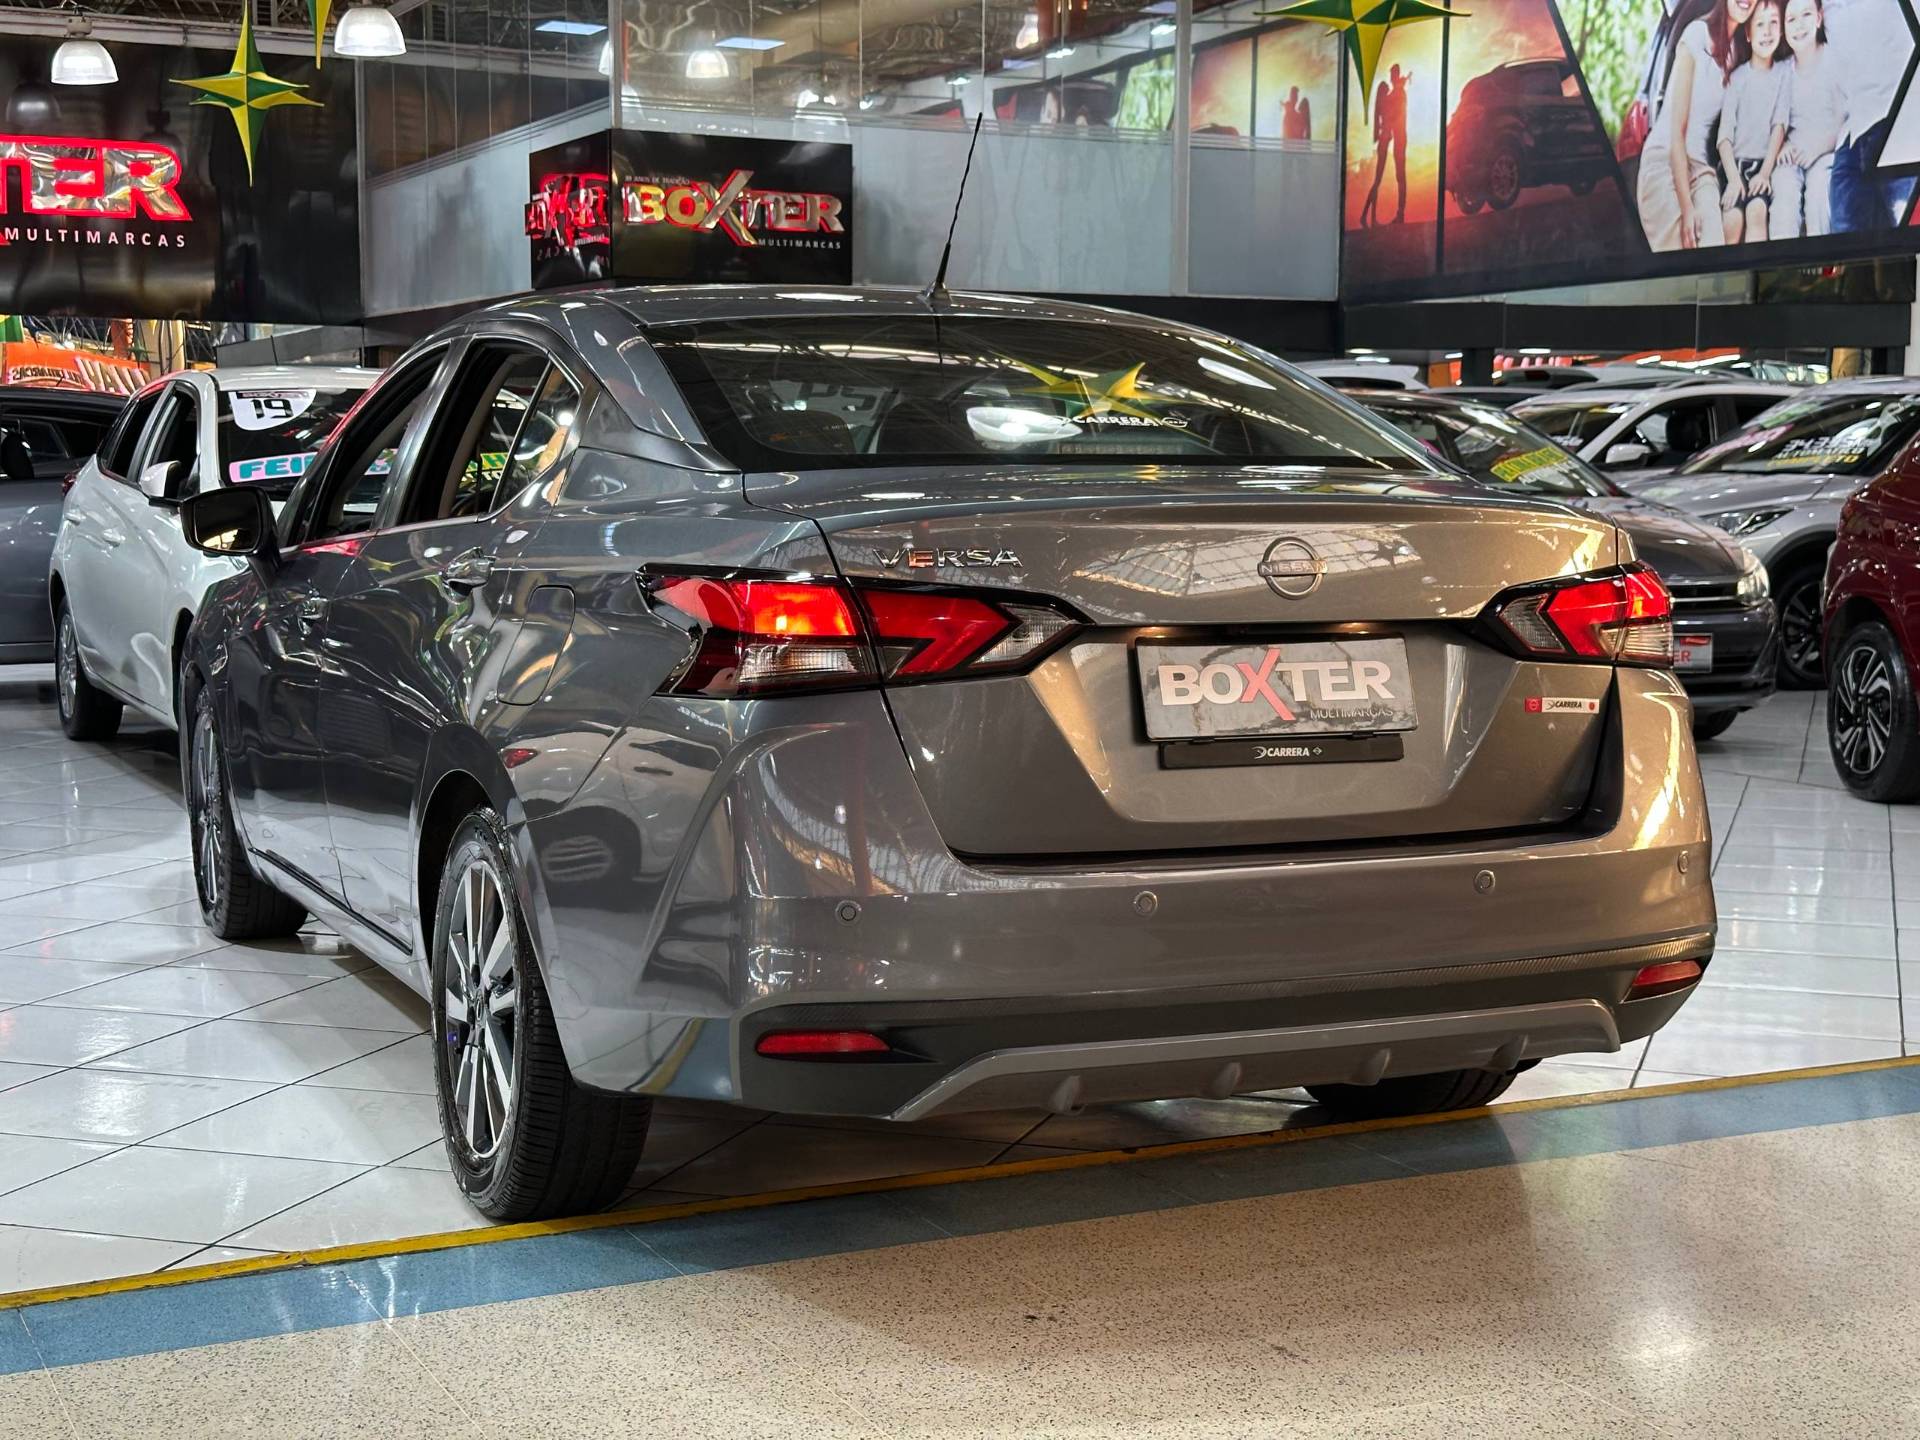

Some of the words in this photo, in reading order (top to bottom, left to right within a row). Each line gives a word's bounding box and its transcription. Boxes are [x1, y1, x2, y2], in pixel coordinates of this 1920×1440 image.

[622, 169, 845, 247] BOXTER
[4, 227, 186, 248] MULTIMARCAS
[757, 238, 842, 249] MULTIMARCAS
[250, 398, 295, 420] 19
[873, 548, 1023, 568] VERSA
[1261, 562, 1327, 575] NISSAN
[1158, 648, 1395, 720] BOXTER
[1310, 708, 1394, 719] MULTIMARCAS
[1267, 748, 1310, 757] CARRERA
